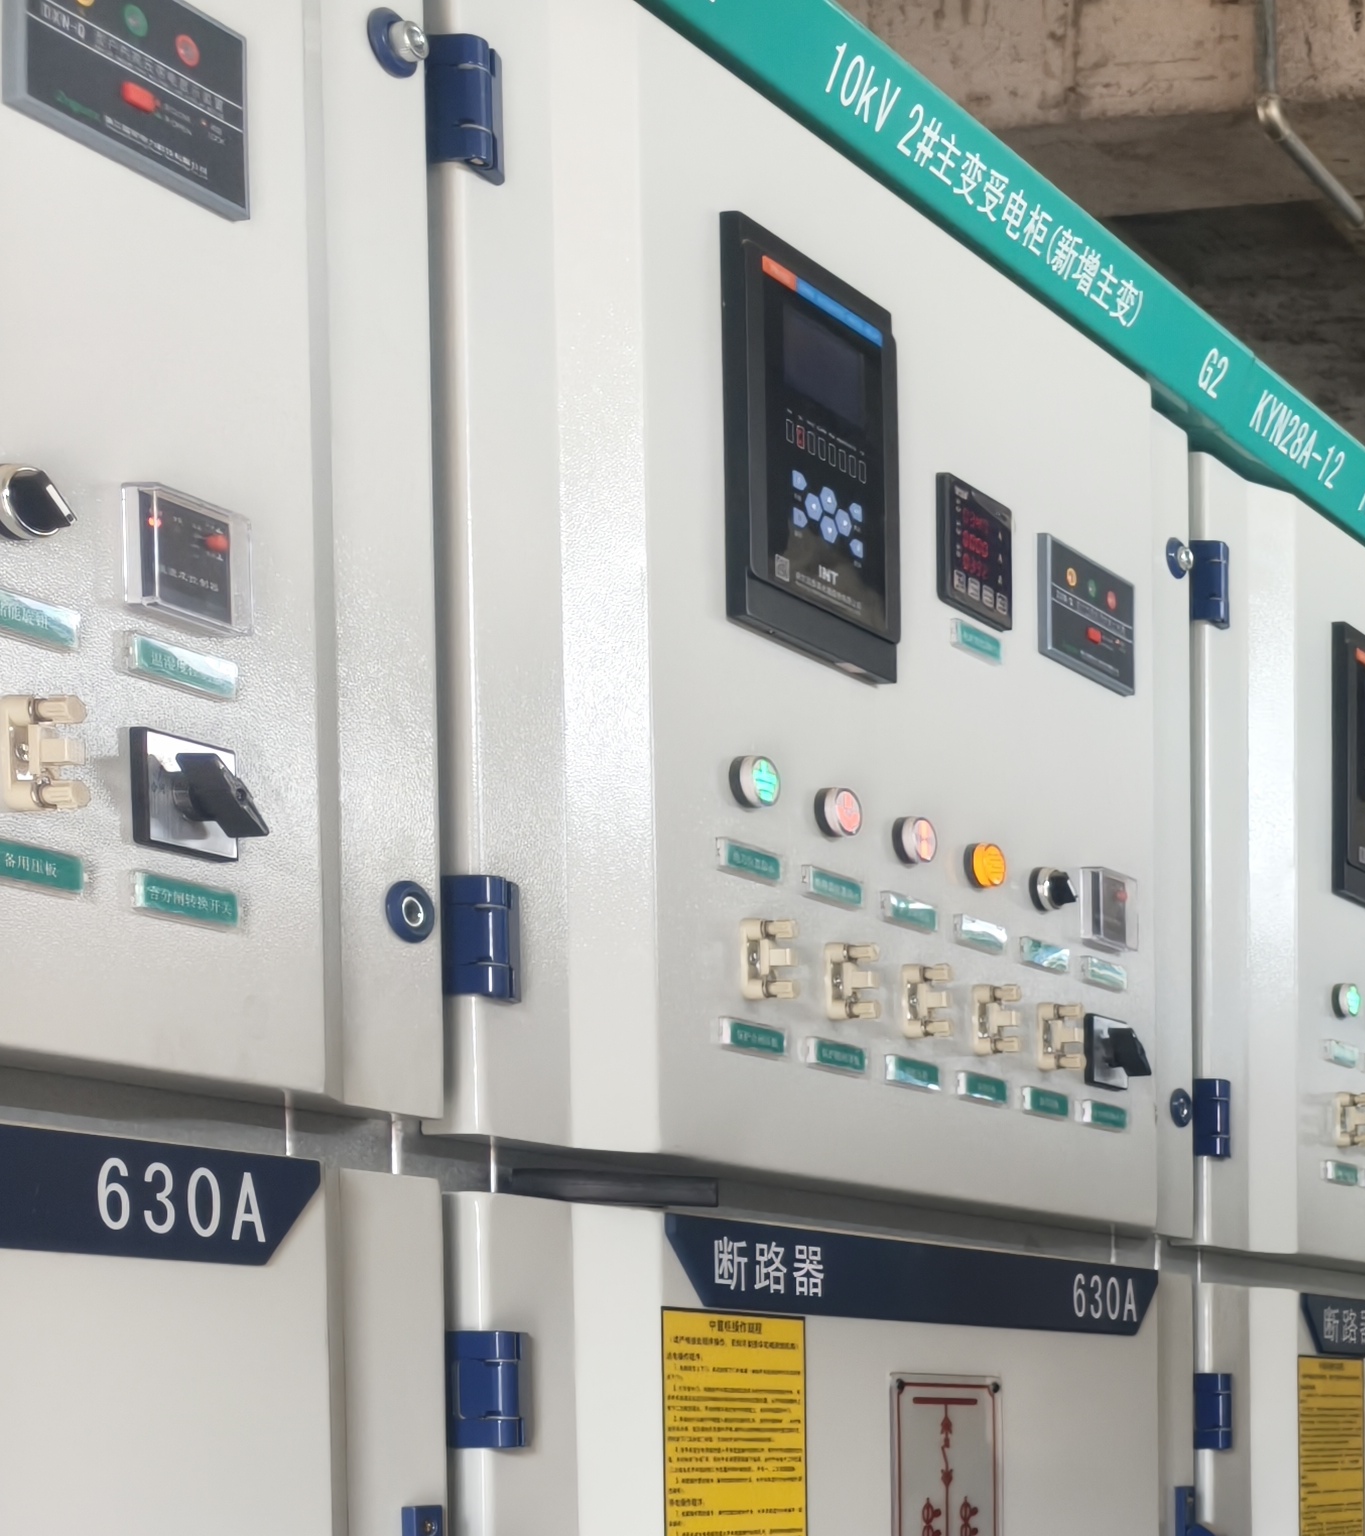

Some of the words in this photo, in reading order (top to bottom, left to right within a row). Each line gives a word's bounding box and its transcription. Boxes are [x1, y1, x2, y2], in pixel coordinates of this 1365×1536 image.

[825, 42, 901, 132] 10kV
[896, 103, 1144, 328] 2#主变受电柜(新增主变)
[1198, 347, 1229, 400] G2
[1249, 389, 1346, 490] KYN28A-12
[4, 852, 58, 879] 备用压板
[97, 1157, 266, 1243] 630A
[712, 1236, 825, 1297] 断路器
[1072, 1273, 1138, 1322] 630A
